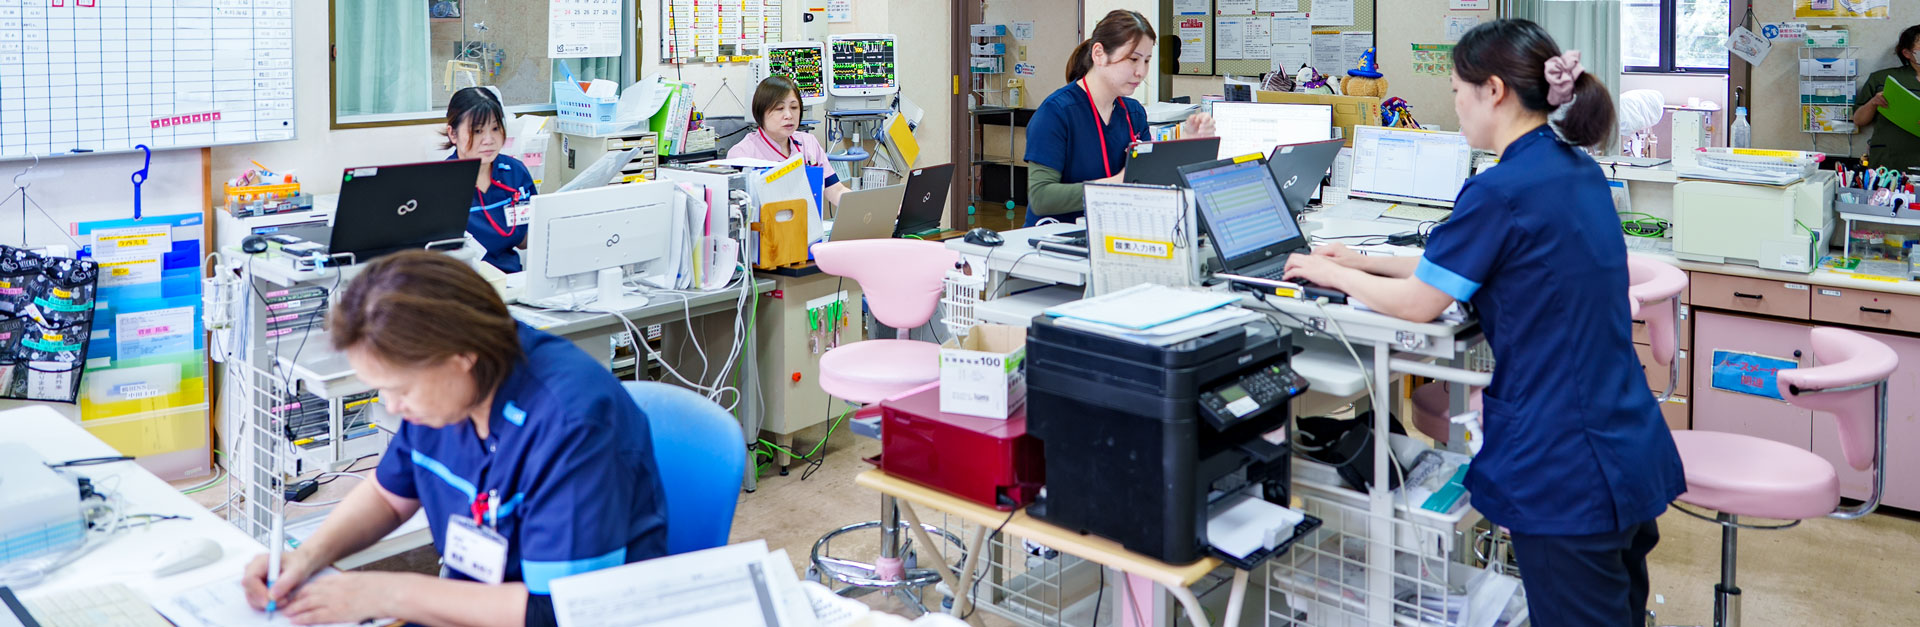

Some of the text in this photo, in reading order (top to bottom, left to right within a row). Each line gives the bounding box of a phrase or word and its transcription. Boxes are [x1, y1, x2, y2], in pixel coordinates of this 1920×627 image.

[1115, 241, 1165, 255] 酸素入力待ち
[1740, 375, 1764, 388] 関連
